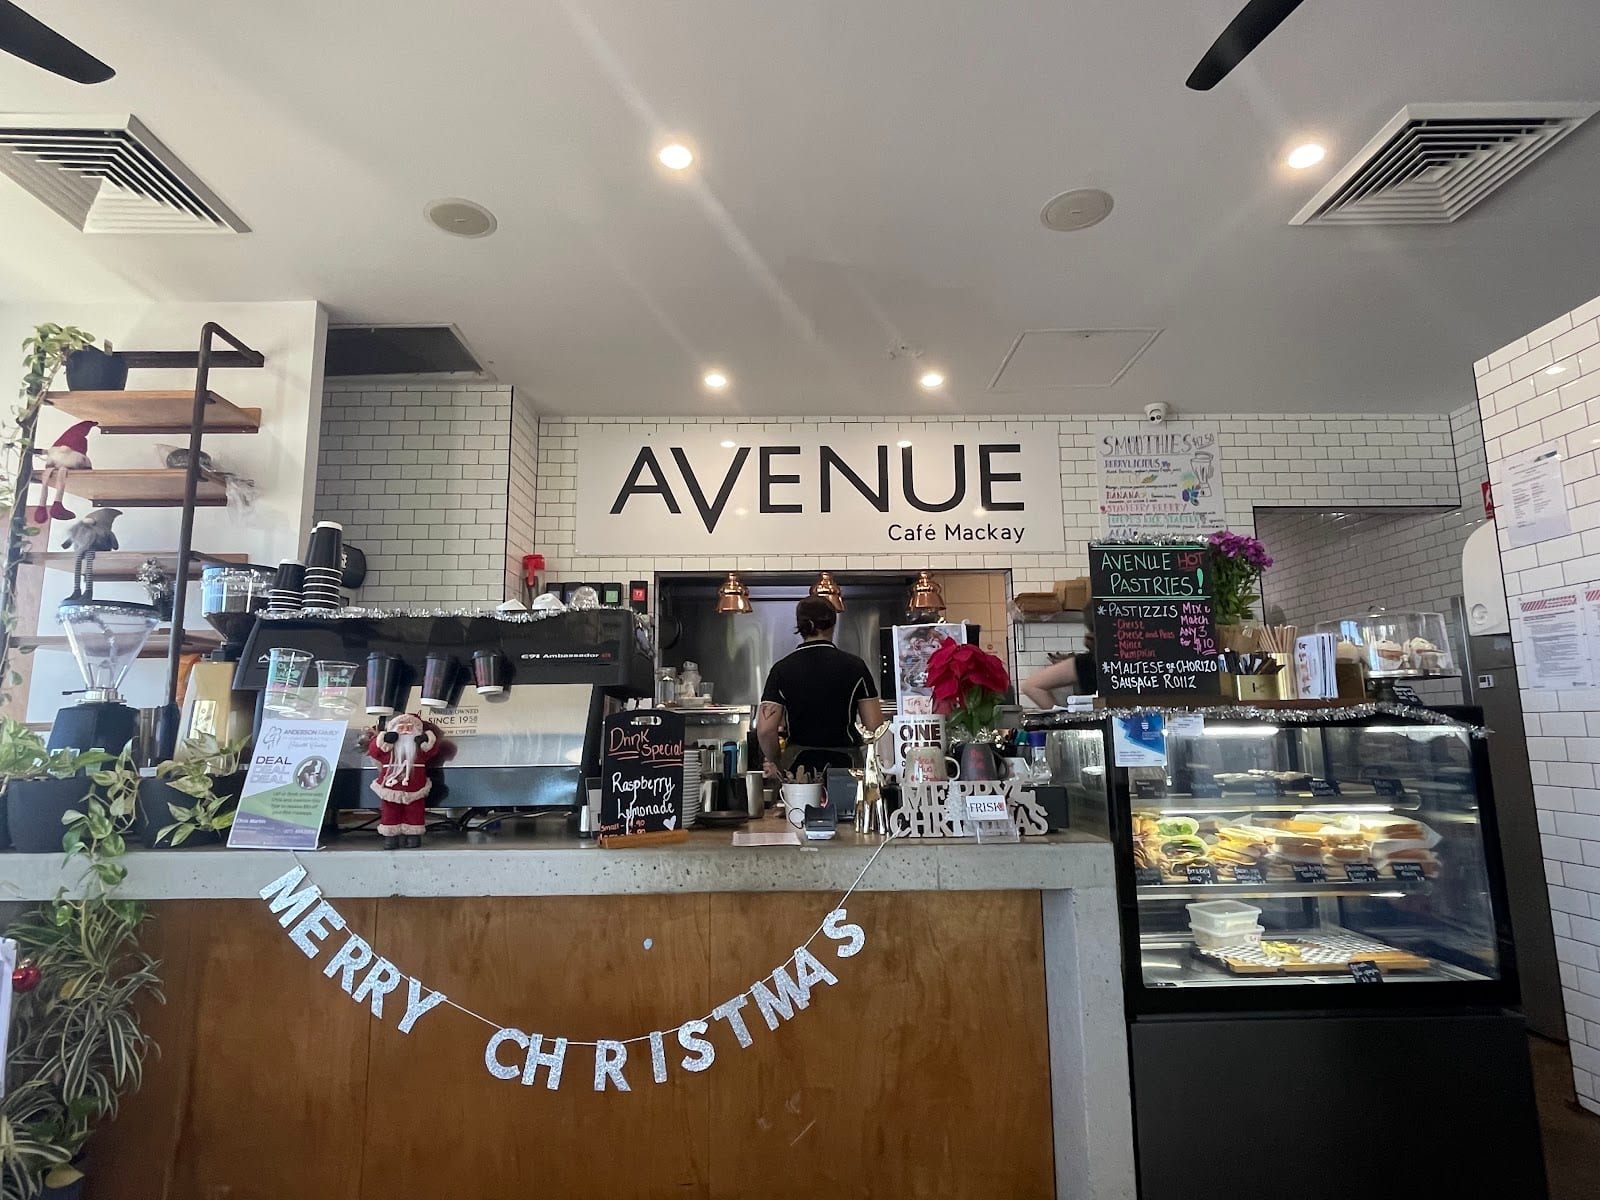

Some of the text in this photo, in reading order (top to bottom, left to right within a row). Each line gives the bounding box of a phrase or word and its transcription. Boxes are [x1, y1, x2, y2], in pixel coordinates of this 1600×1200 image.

[1100, 433, 1192, 456] SMOOTHIES
[609, 444, 1025, 534] AVENUE
[888, 523, 1025, 544] Café Mackay
[1101, 551, 1205, 572] AVENUE HOT
[1182, 602, 1202, 614] MIX
[1199, 626, 1208, 638] 3
[1193, 637, 1214, 654] $10
[1110, 660, 1164, 675] MALTESE
[1176, 659, 1217, 673] CHORIZO
[1111, 675, 1160, 694] SAUSAGE
[428, 716, 455, 725] SINCE
[609, 727, 650, 752] Drink
[900, 724, 941, 741] ONE
[255, 756, 293, 765] DEAL
[249, 774, 288, 783] DEAL
[612, 771, 676, 802] Raspberry
[890, 809, 1048, 838] CHRIAS
[259, 864, 448, 1034] MERRY
[484, 908, 866, 1092] CHRISTMAS
